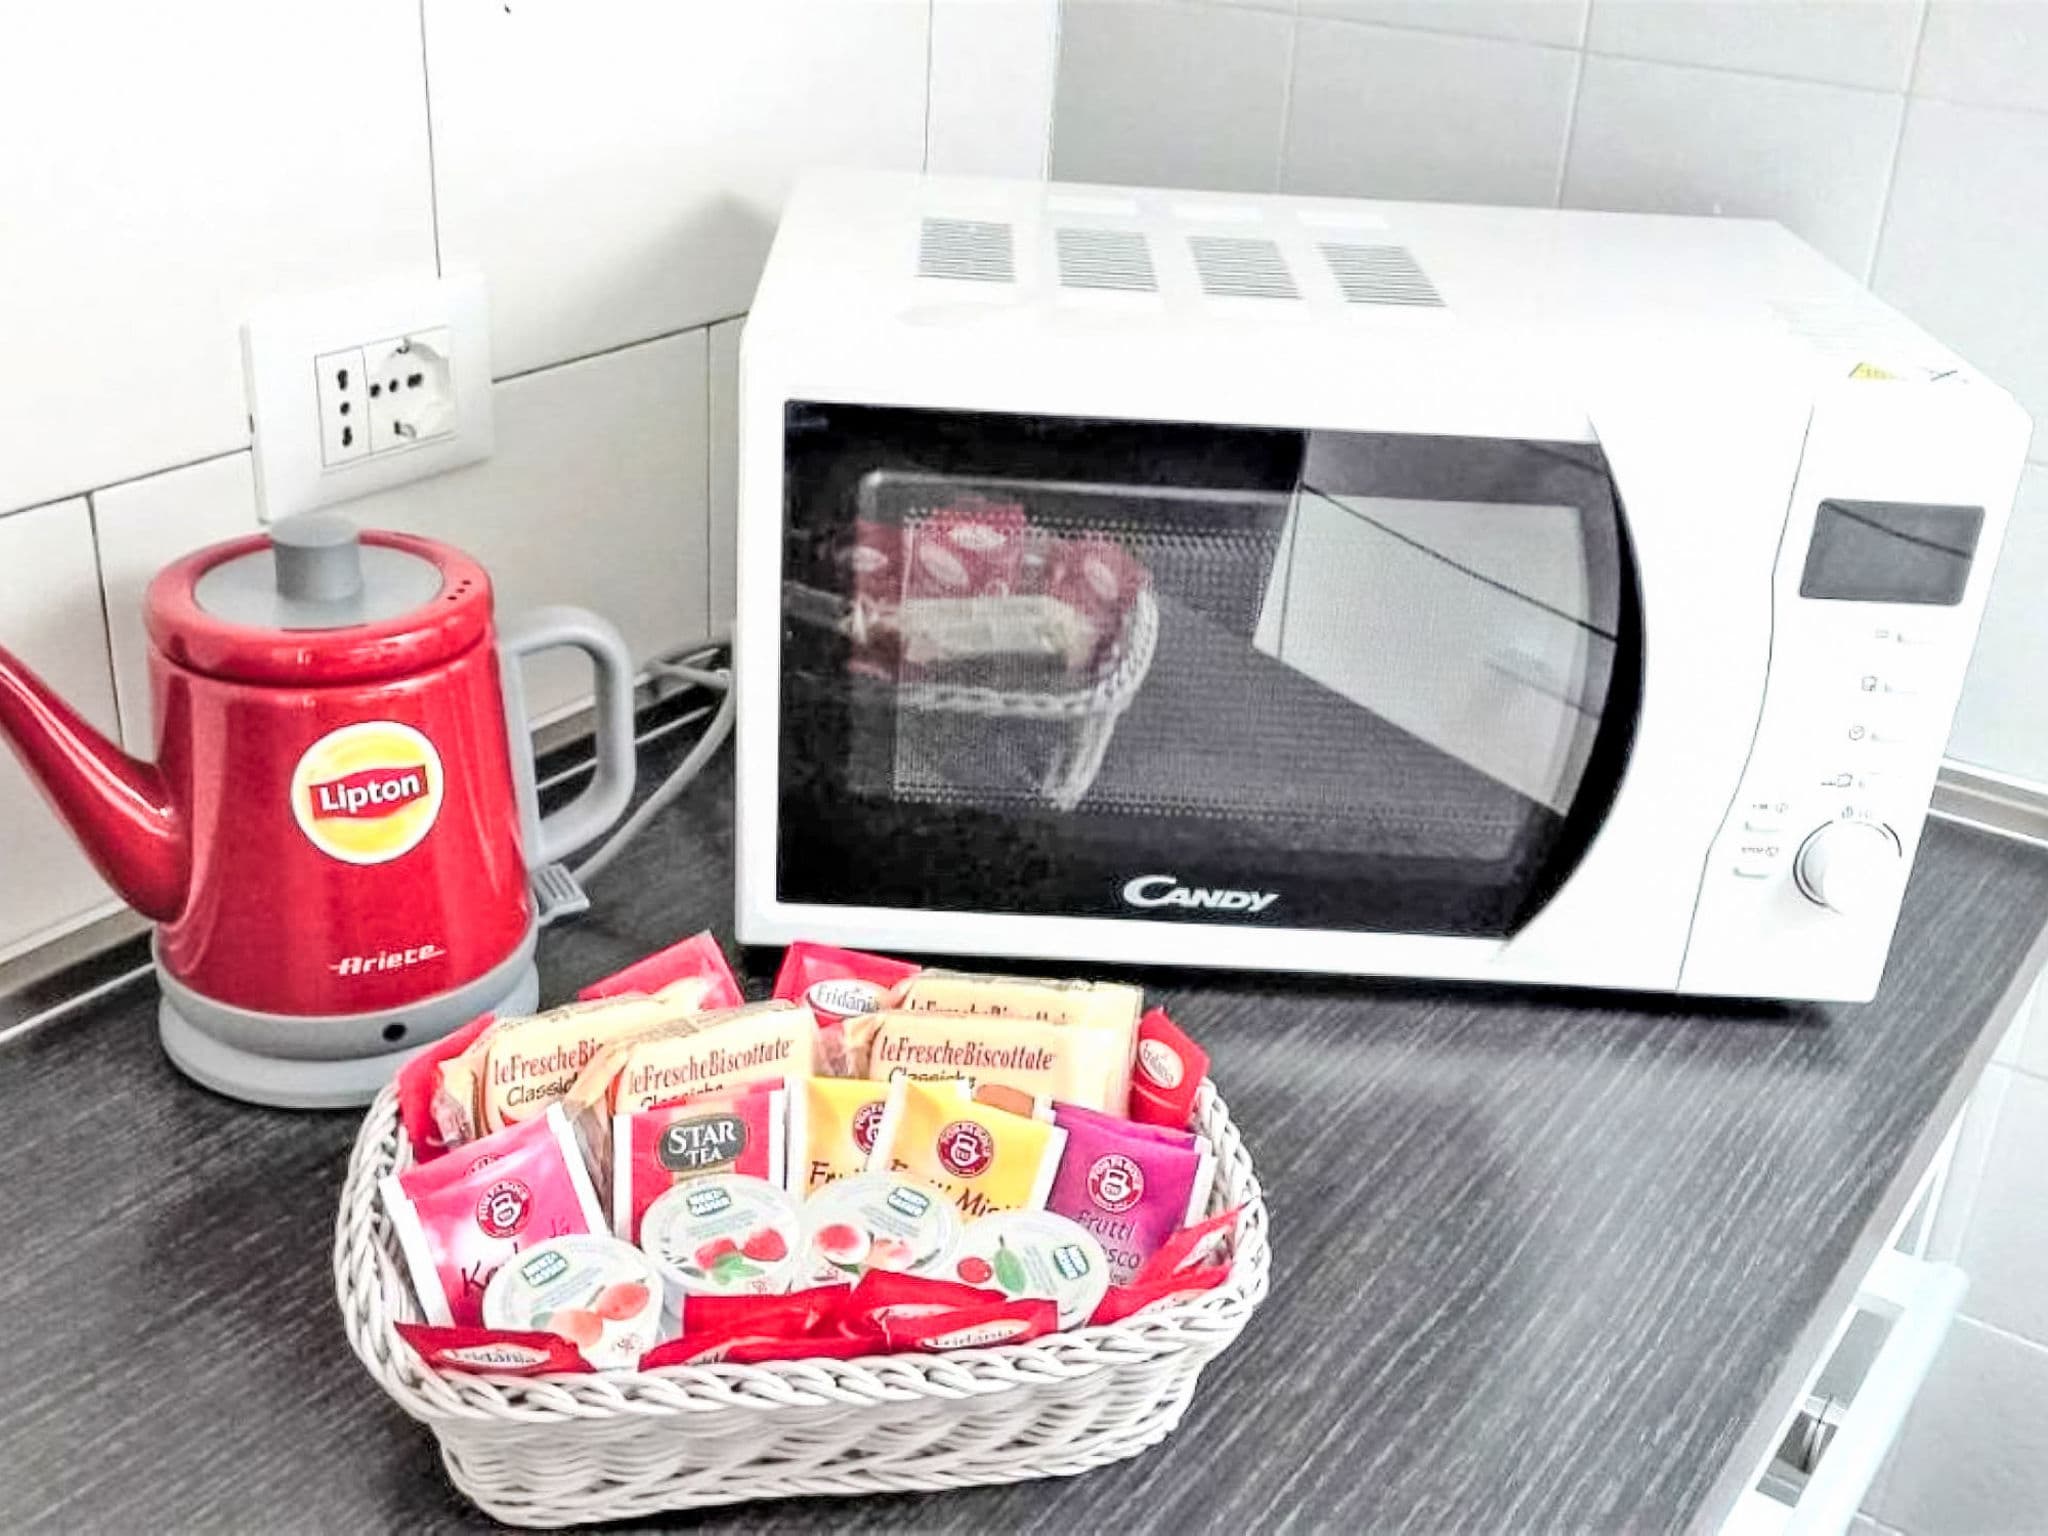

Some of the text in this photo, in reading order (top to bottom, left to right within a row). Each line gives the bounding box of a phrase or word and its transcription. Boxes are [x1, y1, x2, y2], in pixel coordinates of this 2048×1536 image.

[318, 774, 421, 814] Lipton
[1123, 874, 1280, 913] CANDY
[329, 944, 446, 976] Ariete
[667, 1120, 738, 1155] STAR
[685, 1147, 723, 1167] TEA
